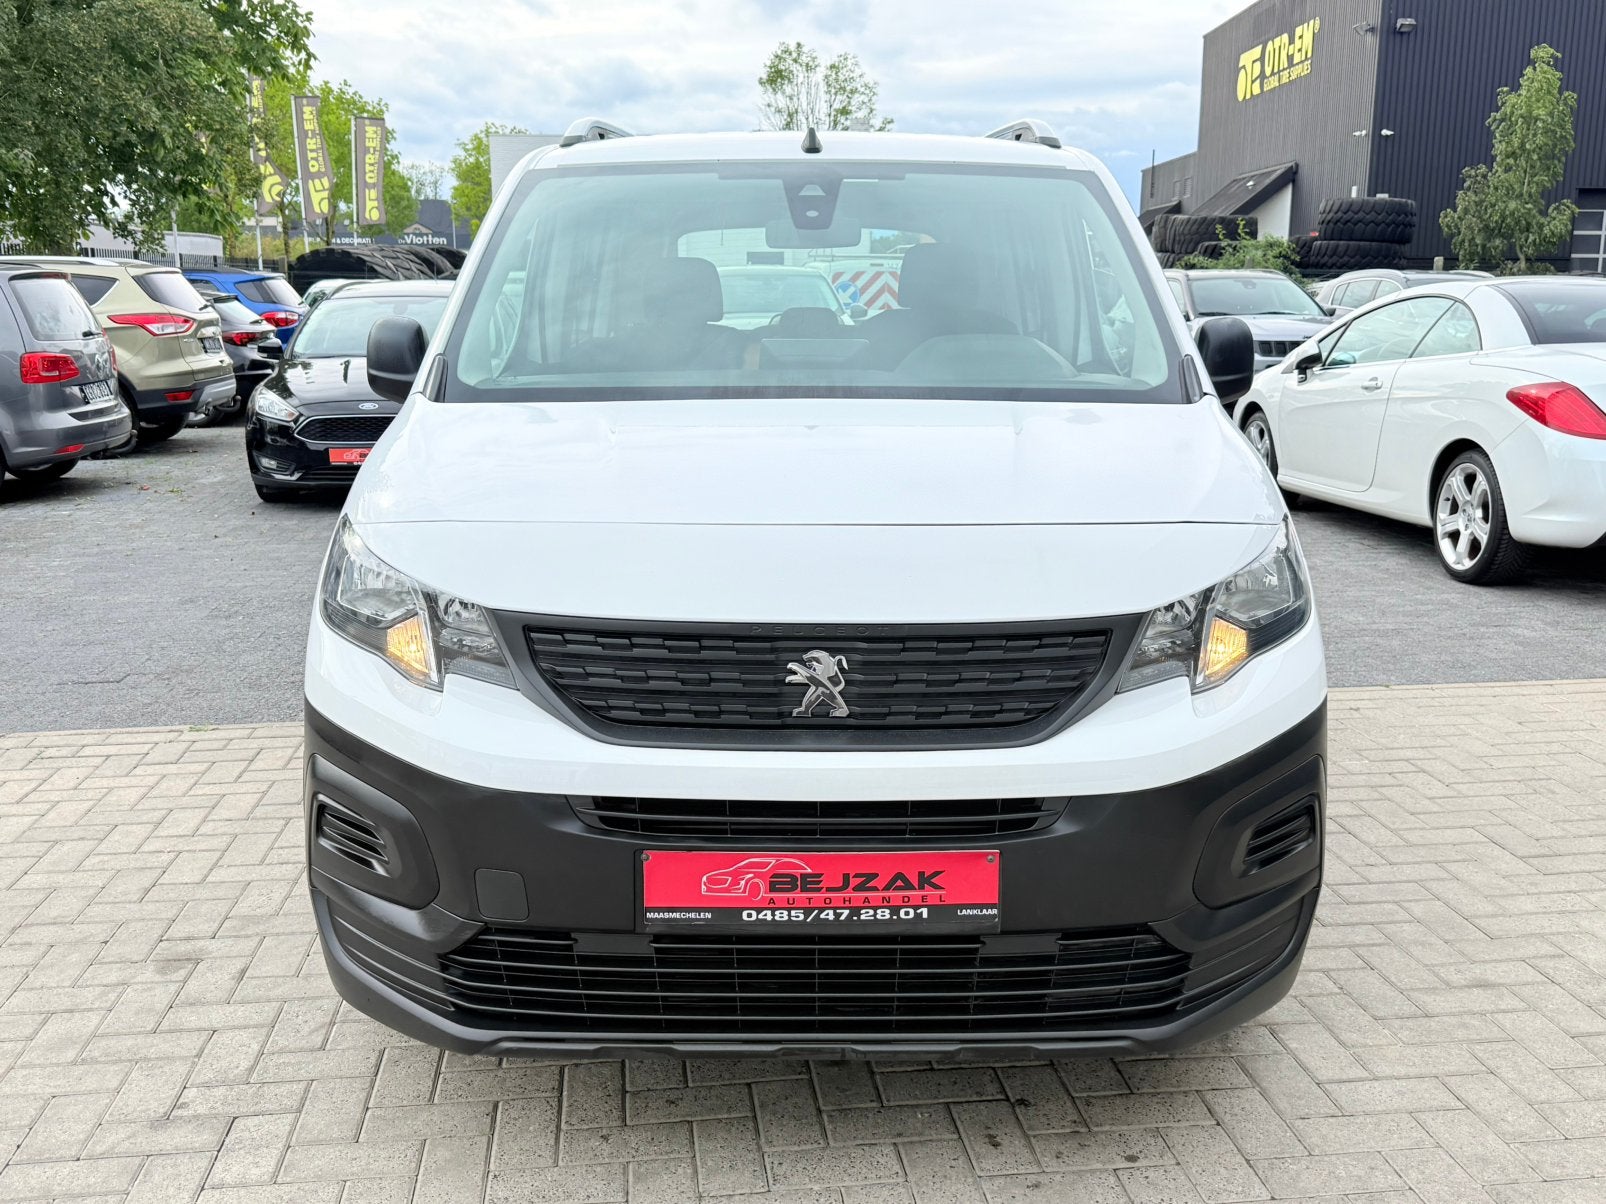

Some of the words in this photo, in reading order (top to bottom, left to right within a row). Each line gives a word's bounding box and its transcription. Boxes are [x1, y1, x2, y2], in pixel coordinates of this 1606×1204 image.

[404, 234, 448, 245] Vlotten
[768, 870, 946, 893] BEJZAK
[767, 895, 946, 906] AUTOHANDEL
[741, 907, 929, 922] 0485/47.28.01
[957, 908, 998, 916] LANKLAAR
